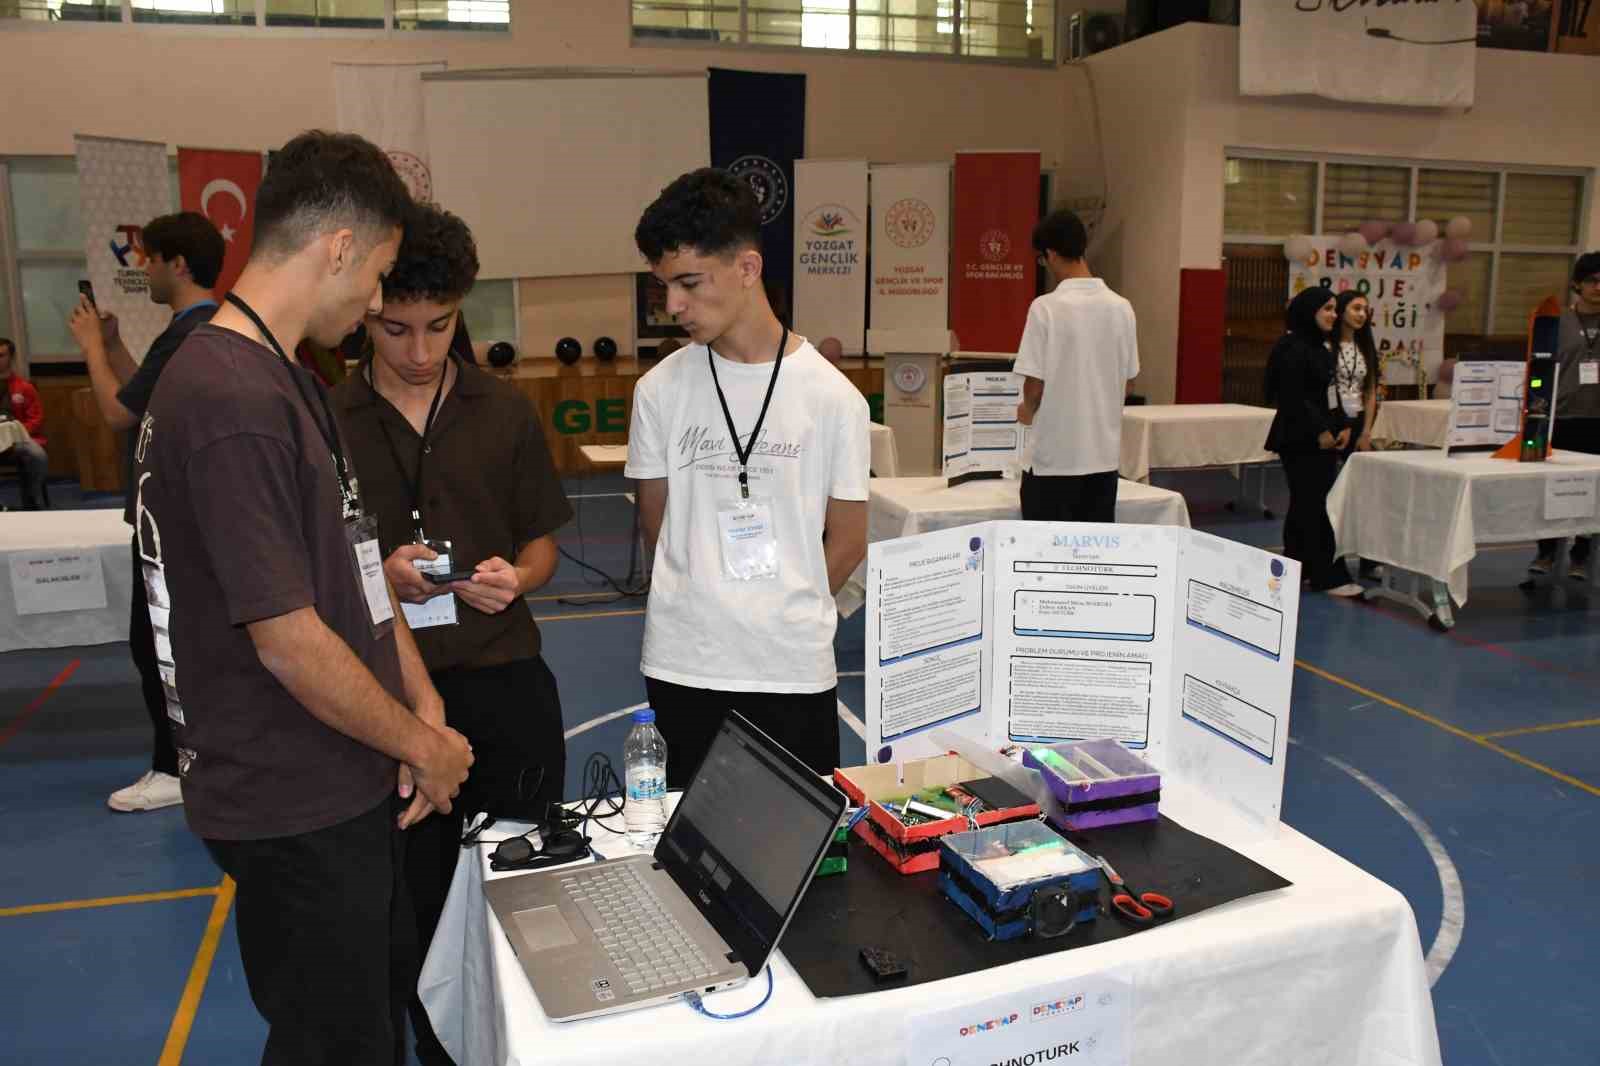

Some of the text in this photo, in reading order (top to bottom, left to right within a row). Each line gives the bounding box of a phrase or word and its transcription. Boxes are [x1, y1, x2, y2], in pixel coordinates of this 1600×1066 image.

[805, 240, 854, 250] YOZGAT
[678, 426, 726, 462] Mavi
[1054, 535, 1120, 547] MARVIS
[959, 1013, 1019, 1037] DENEYAP
[1033, 996, 1082, 1015] DENEYAP
[990, 1040, 1080, 1066] NOTURK
